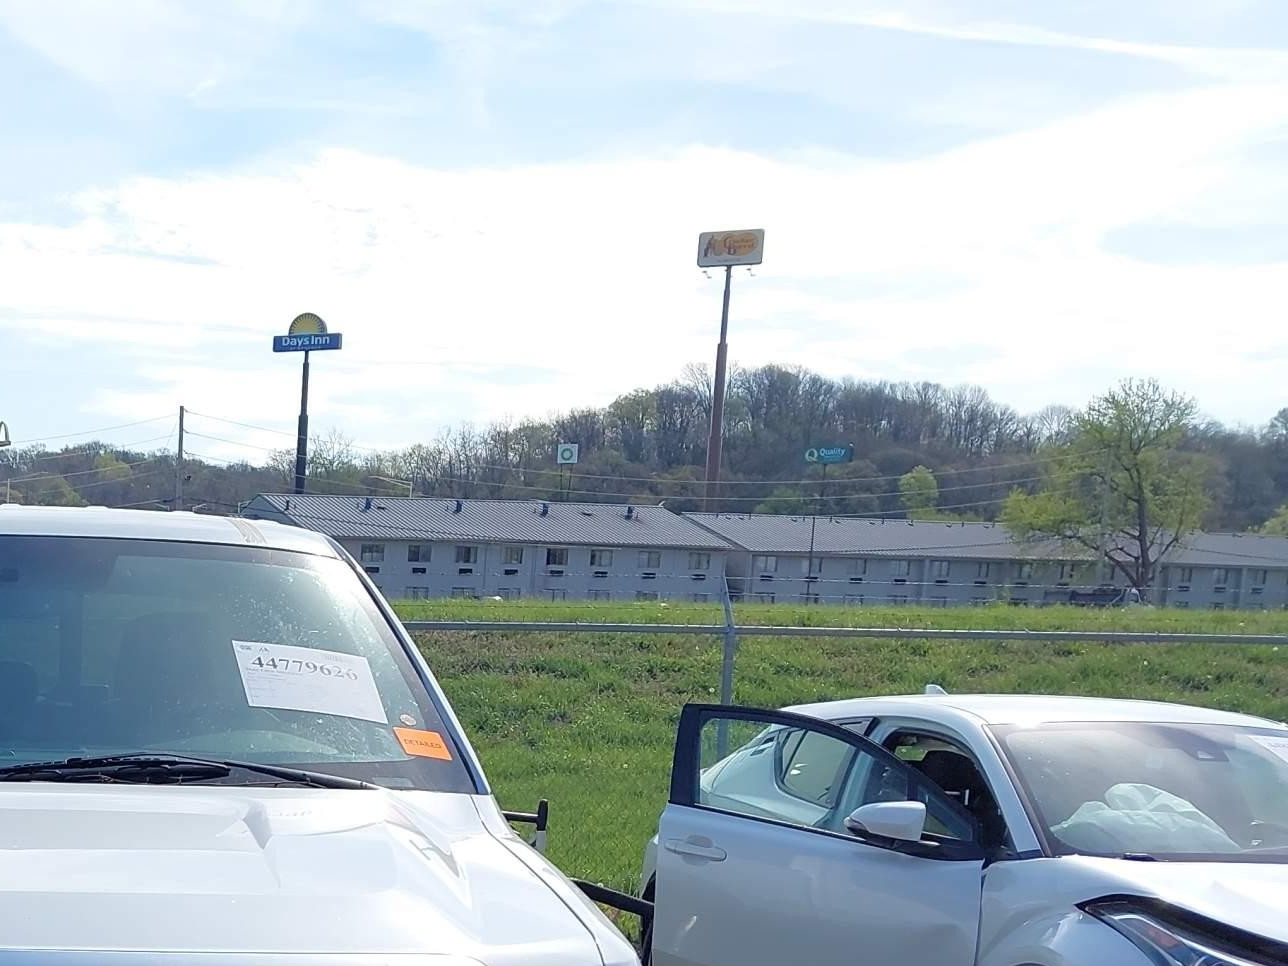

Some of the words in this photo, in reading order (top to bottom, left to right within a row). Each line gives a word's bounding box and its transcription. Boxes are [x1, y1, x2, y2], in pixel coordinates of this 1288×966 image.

[282, 336, 310, 347] Days
[312, 336, 330, 345] Inn
[820, 448, 846, 456] Quality
[251, 656, 358, 681] 44779626
